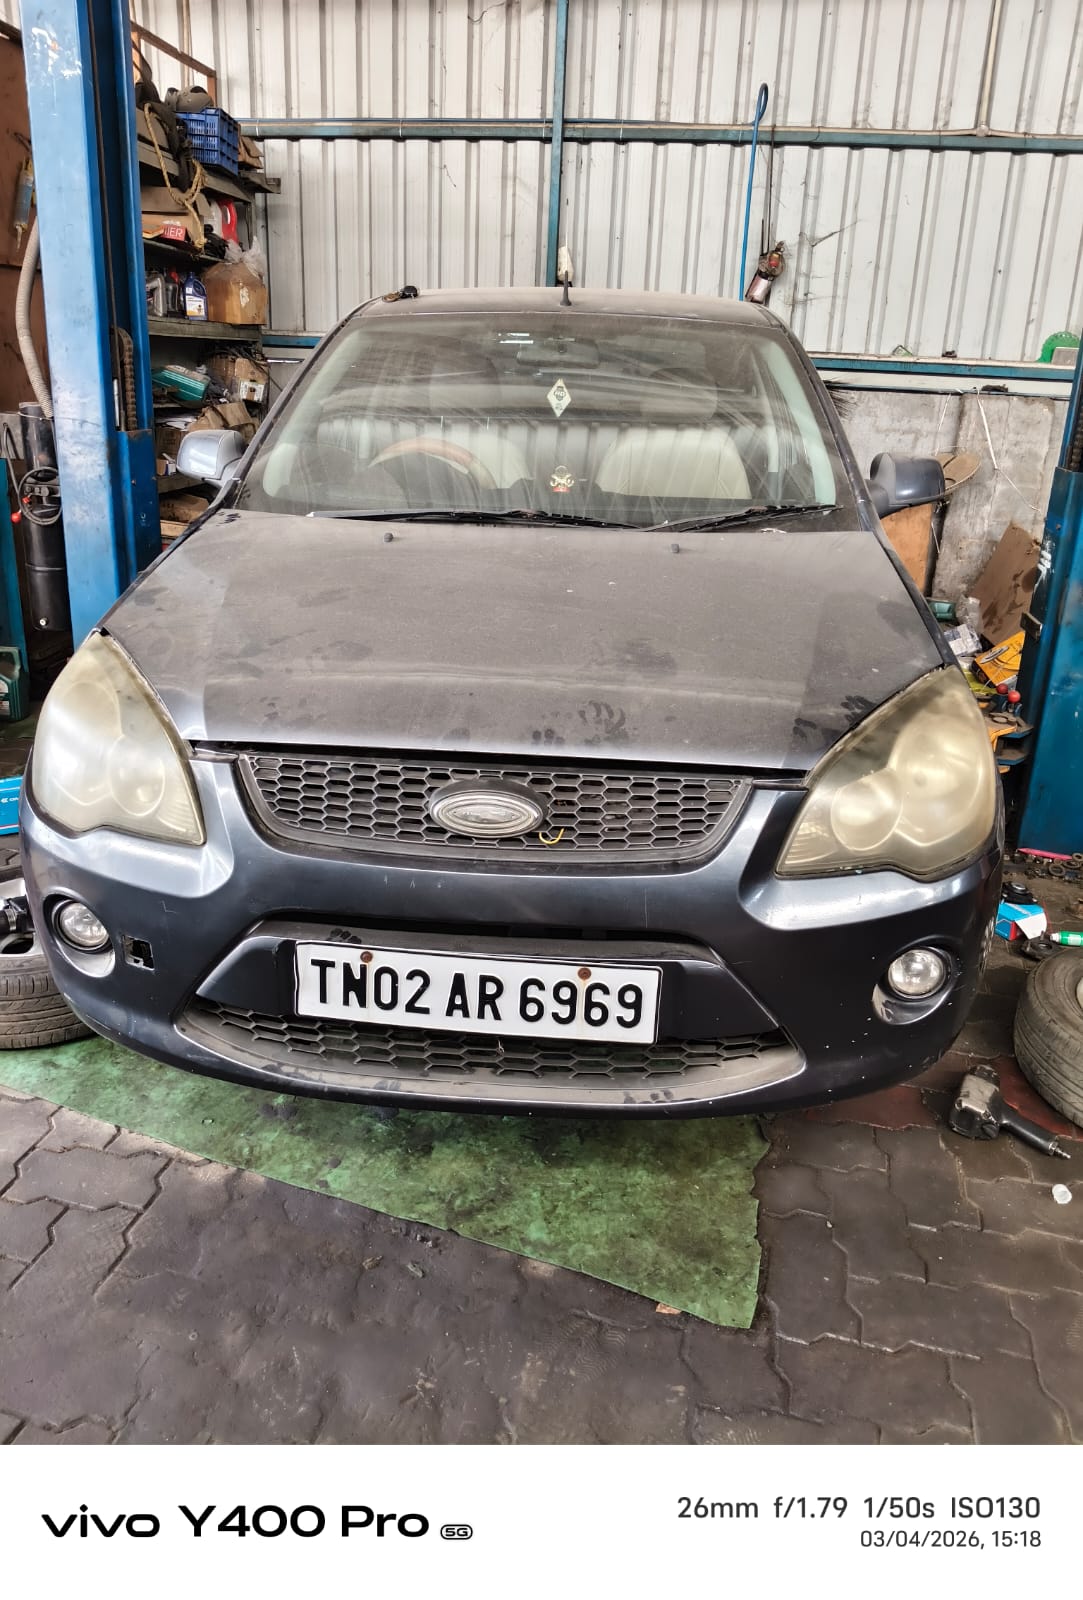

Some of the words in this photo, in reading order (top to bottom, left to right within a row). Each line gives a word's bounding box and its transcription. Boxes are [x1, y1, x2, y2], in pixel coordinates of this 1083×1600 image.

[310, 958, 431, 1015] TN02
[445, 972, 504, 1021] AR
[519, 977, 643, 1029] 6969
